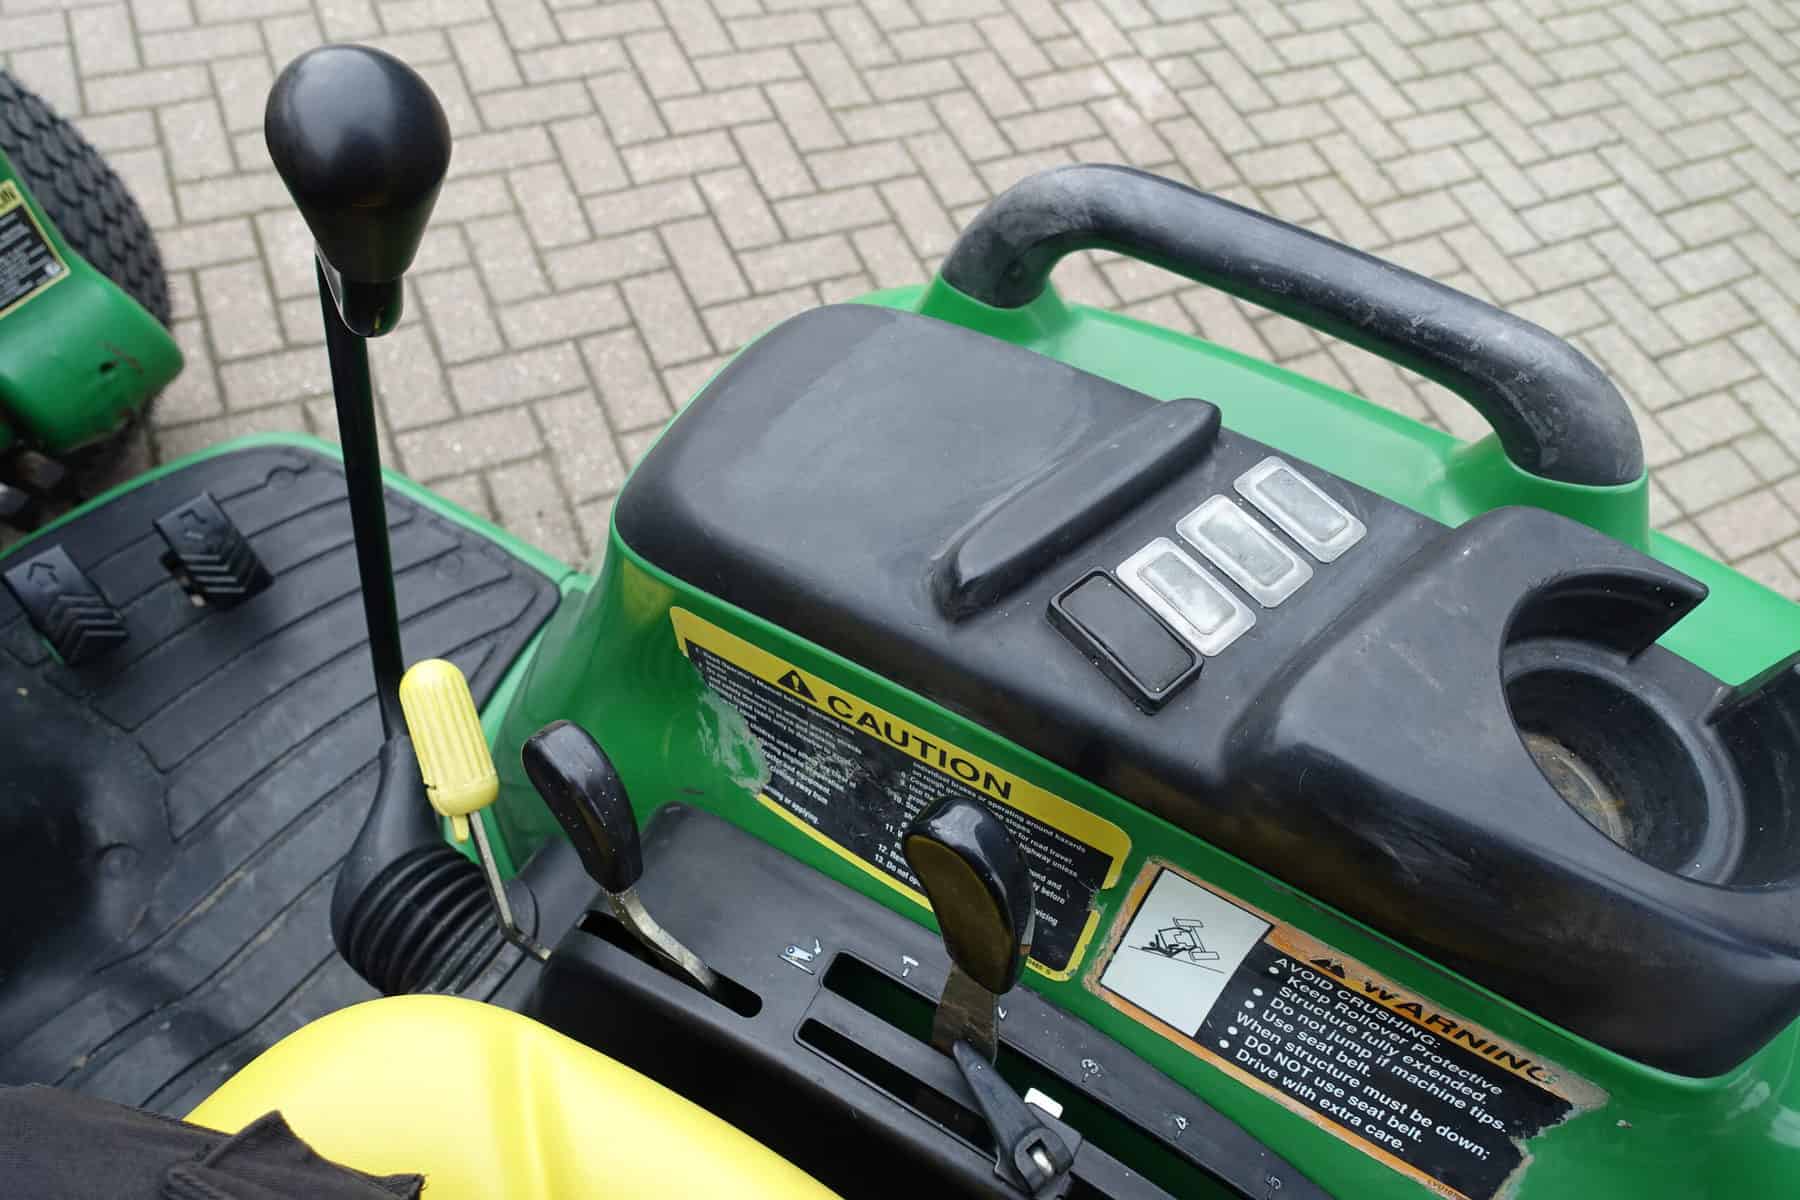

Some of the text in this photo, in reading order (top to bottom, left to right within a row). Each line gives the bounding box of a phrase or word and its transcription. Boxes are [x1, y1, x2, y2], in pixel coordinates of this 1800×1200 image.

[827, 695, 1011, 800] CAUTION
[885, 823, 896, 835] 11.
[987, 800, 1024, 822] operating
[1025, 819, 1053, 836] around
[1005, 817, 1032, 835] slopes.
[875, 853, 885, 866] 13.
[885, 860, 896, 871] Do
[878, 843, 889, 856] 12.
[1017, 832, 1073, 865] for road travel.
[1018, 842, 1050, 863] highway
[1052, 860, 1077, 877] unless
[1040, 886, 1065, 904] before
[1046, 879, 1062, 890] and
[1274, 958, 1440, 1048] AVOID CRUSHING:
[1262, 1009, 1370, 1077] Use seat belt.
[1279, 986, 1486, 1104] Structure fully extended.
[1287, 975, 1502, 1094] Keep Rollover Protective
[1236, 1011, 1490, 1160] When structure must be down;
[1244, 1035, 1421, 1142] DO NOT use seat belt.
[1269, 997, 1505, 1132] Do not jump if machine tips.
[1235, 1048, 1404, 1151] Drive with extra care.
